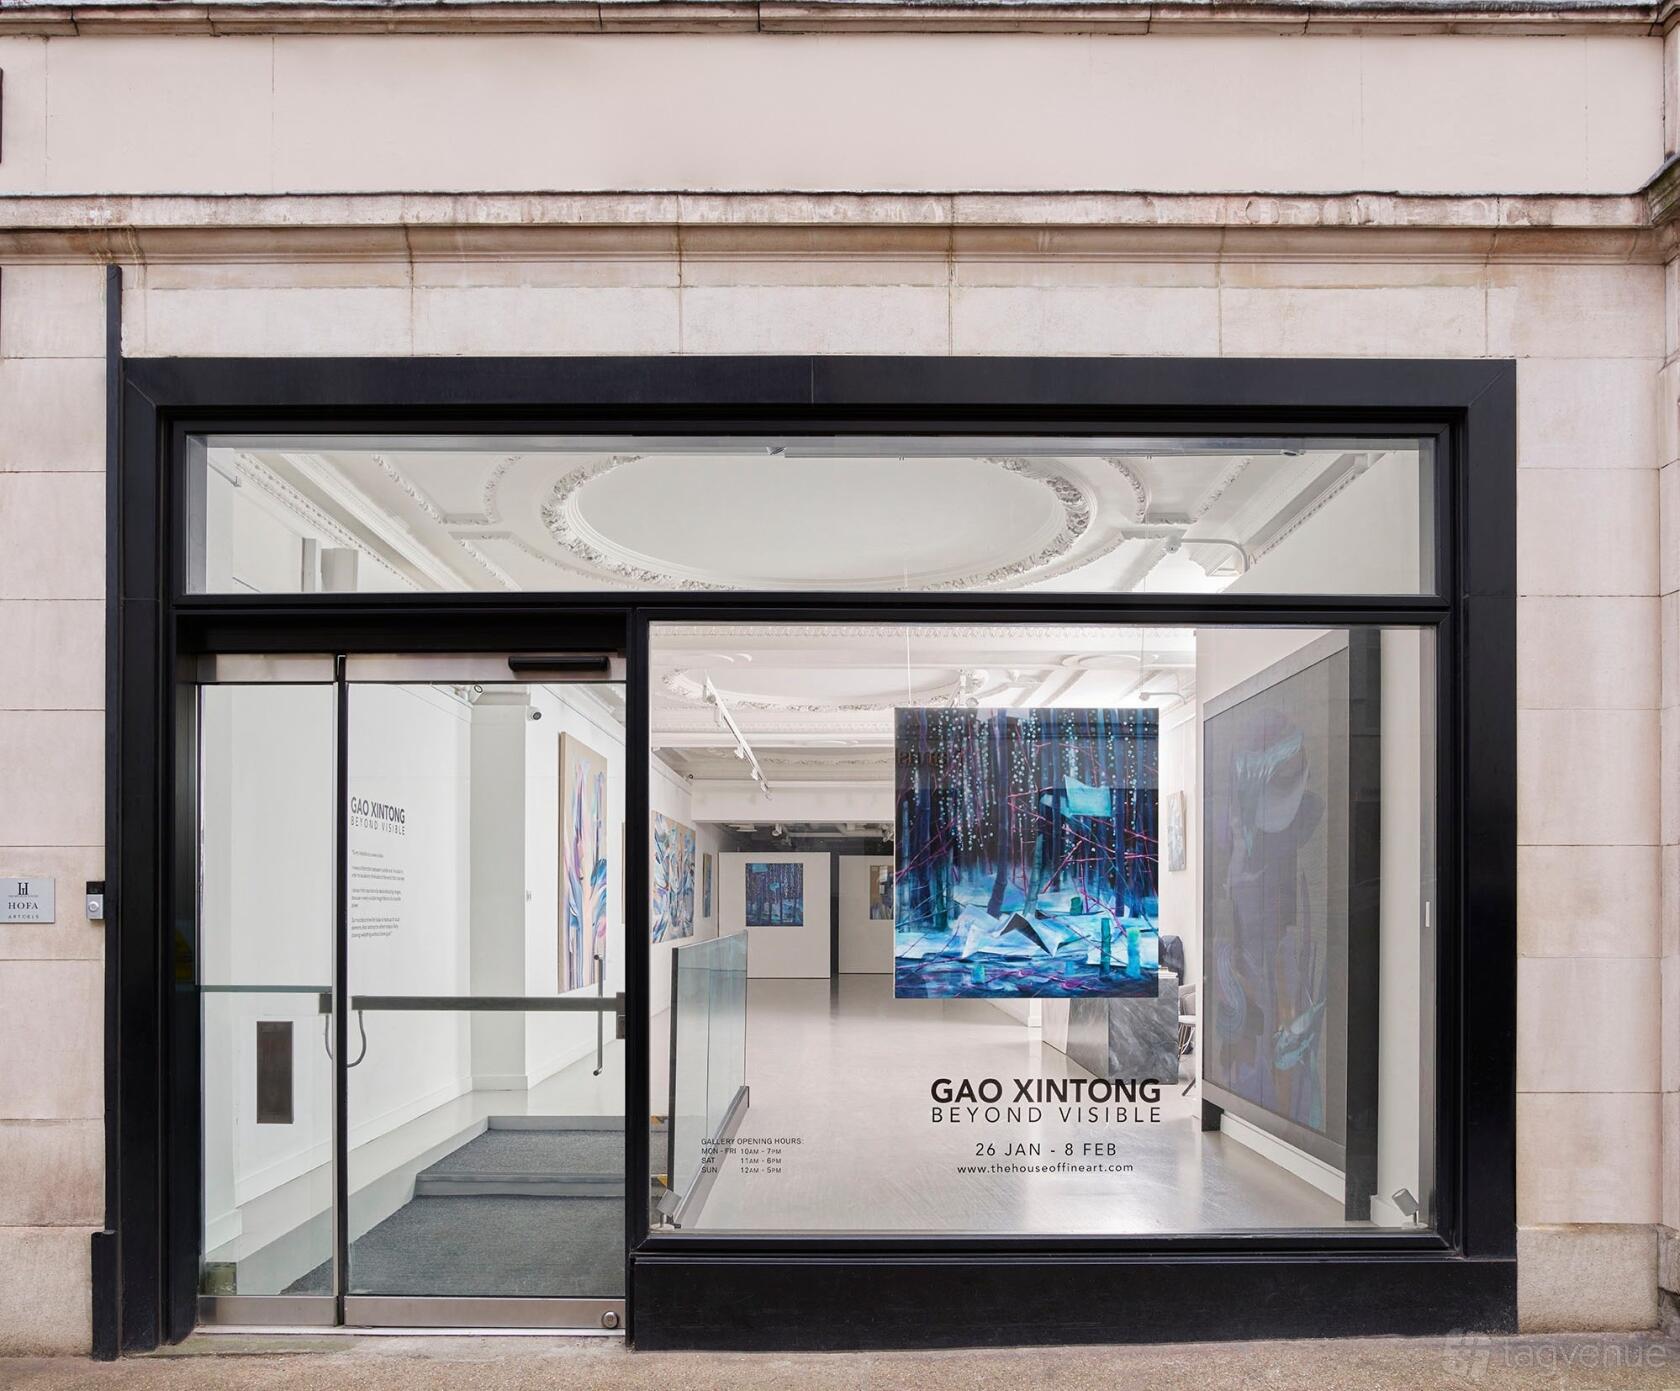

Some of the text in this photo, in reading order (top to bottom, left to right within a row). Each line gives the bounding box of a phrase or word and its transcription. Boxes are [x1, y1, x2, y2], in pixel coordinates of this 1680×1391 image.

[350, 796, 406, 824] GAO XINTONG
[350, 816, 406, 836] BEYOND VISIBLE
[8, 902, 39, 910] HOFA
[931, 1078, 1161, 1104] GAO XINTONG
[932, 1106, 1161, 1123] BEYOND VISIBLE
[737, 1137, 772, 1145] OPENING
[975, 1143, 996, 1156] 26
[1004, 1143, 1041, 1156] JAN
[1064, 1143, 1073, 1156] 8
[1083, 1143, 1117, 1156] FEB
[957, 1162, 1134, 1173] www.thehouseoffineart.com
